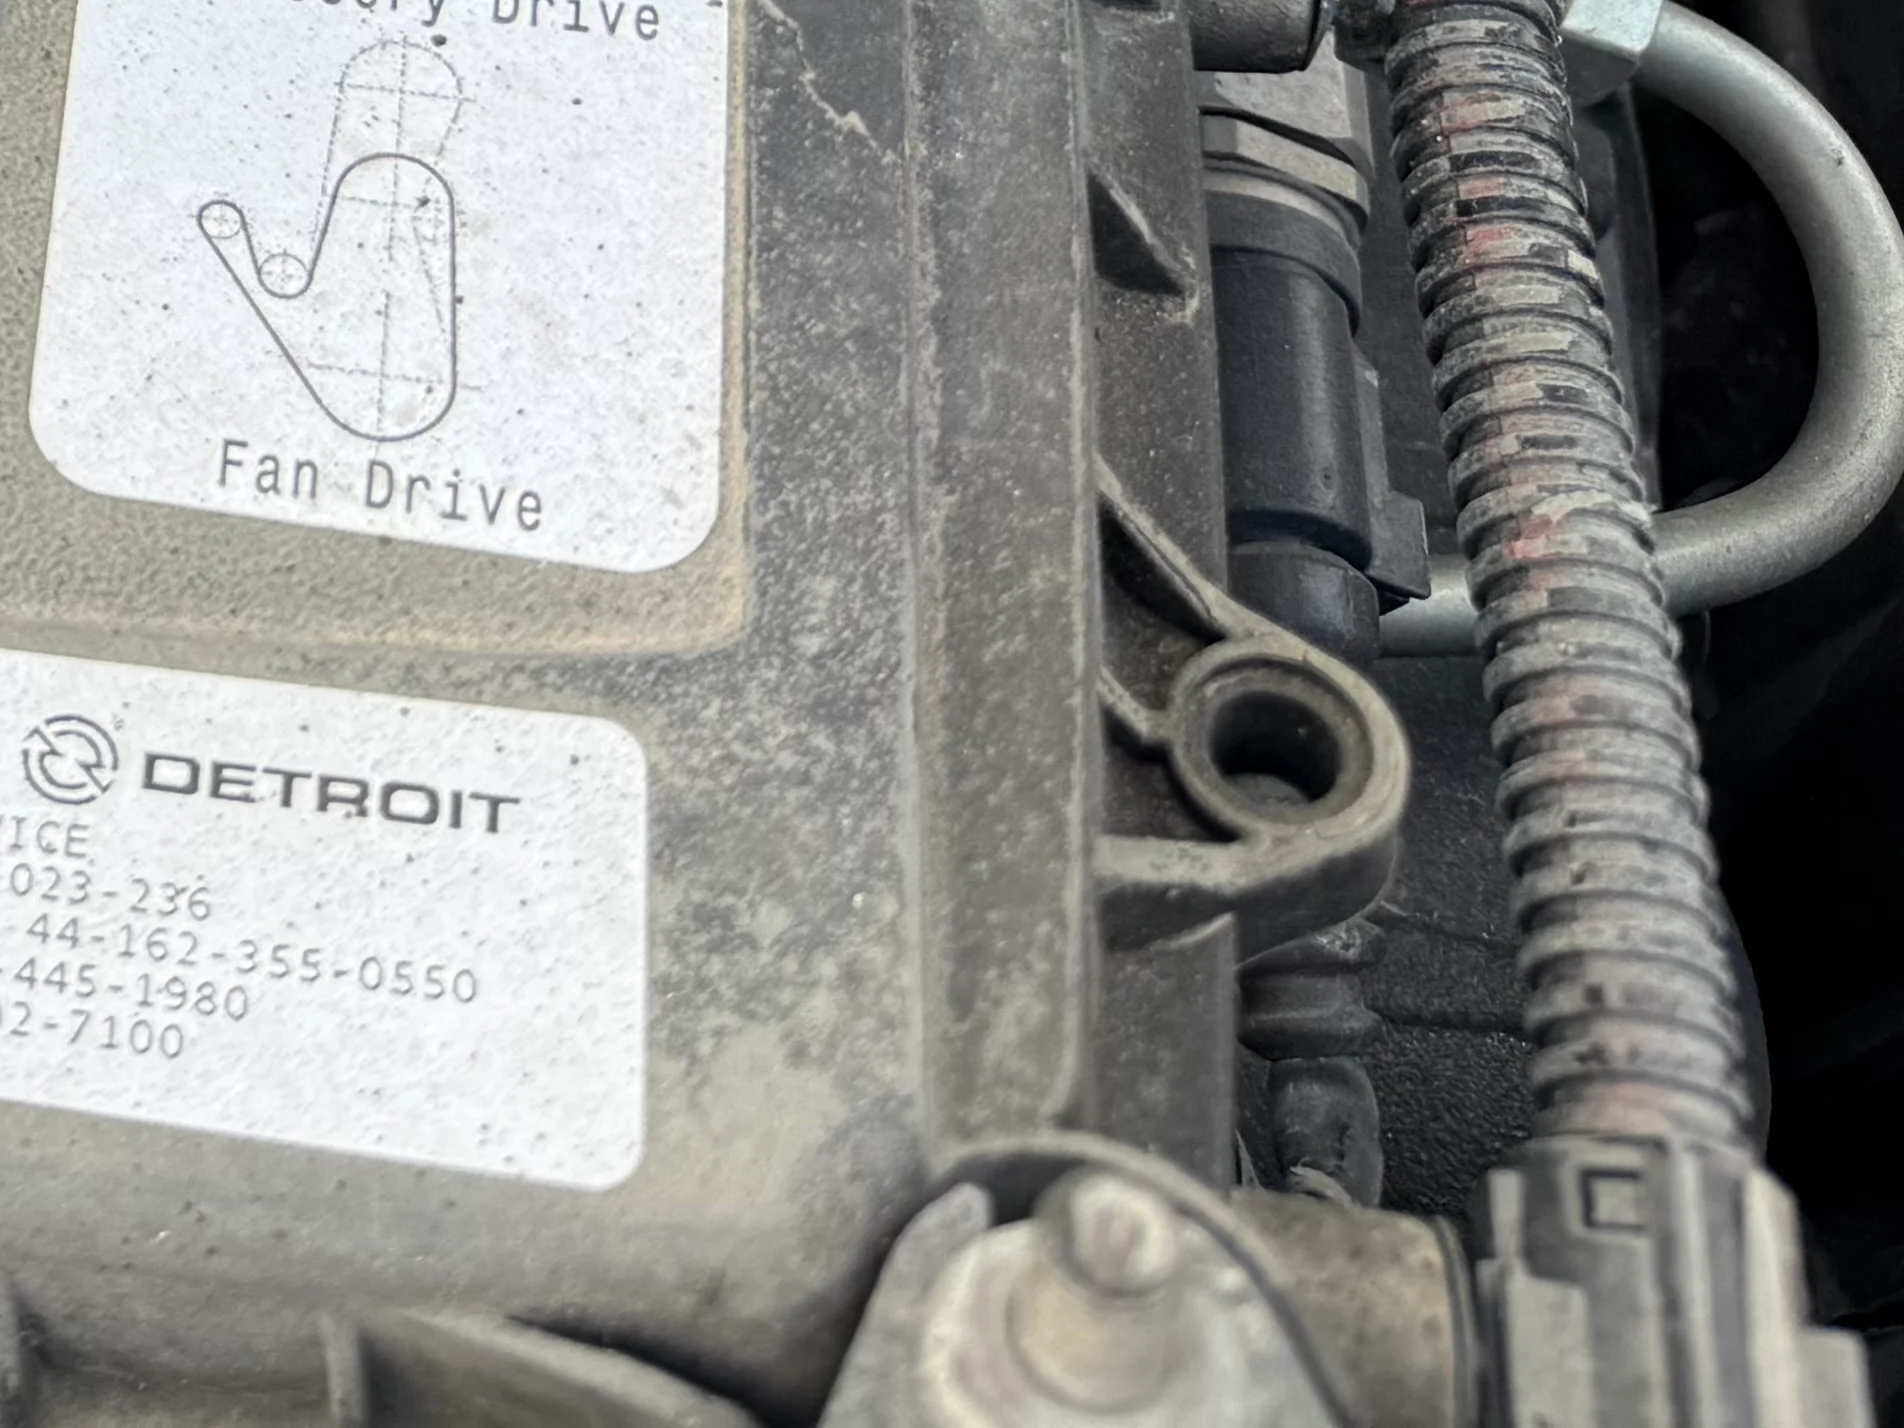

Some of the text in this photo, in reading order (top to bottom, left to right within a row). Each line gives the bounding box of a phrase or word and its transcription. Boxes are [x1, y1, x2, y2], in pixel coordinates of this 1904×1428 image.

[217, 437, 542, 532] Fan Drive
[140, 750, 523, 836] DETROIT
[26, 912, 478, 1005] 44-162-355-0550
